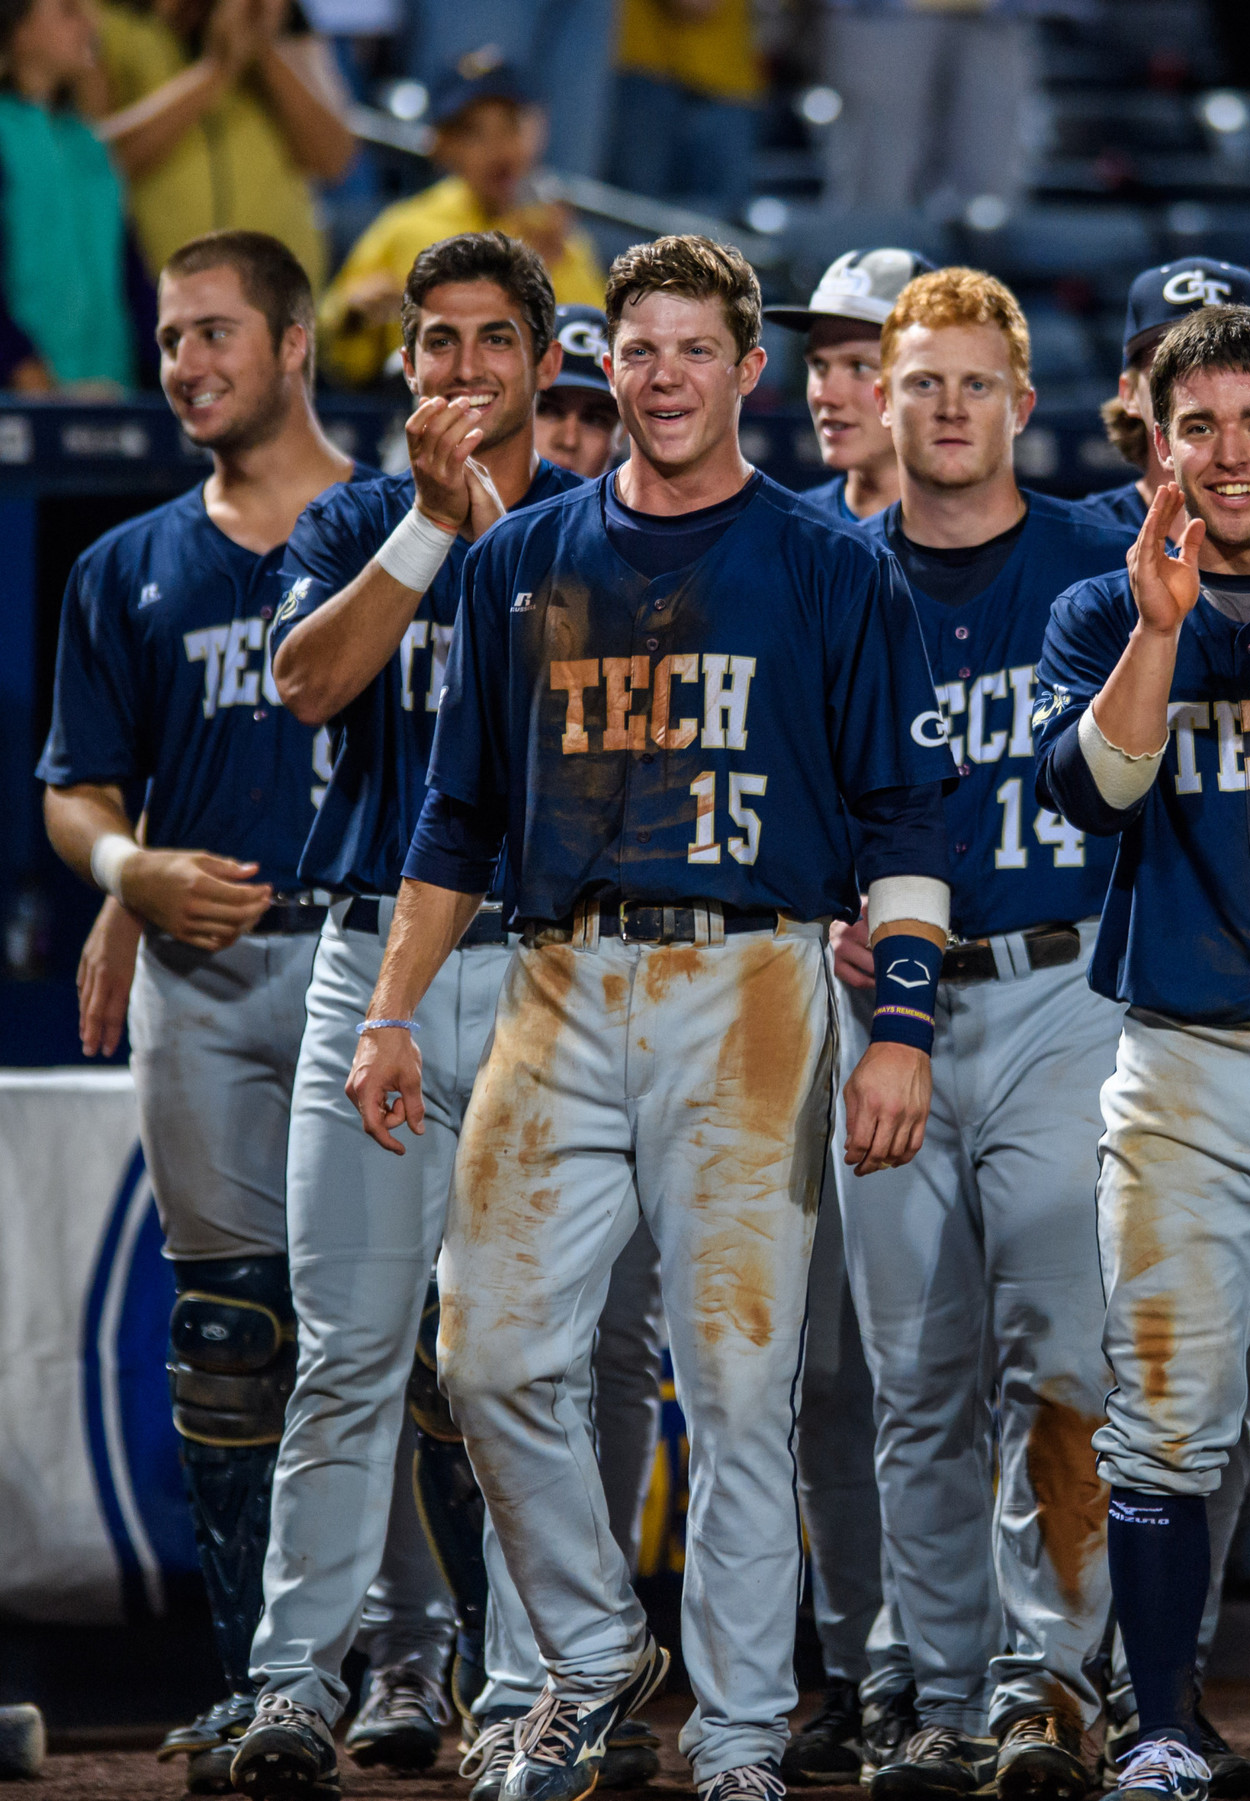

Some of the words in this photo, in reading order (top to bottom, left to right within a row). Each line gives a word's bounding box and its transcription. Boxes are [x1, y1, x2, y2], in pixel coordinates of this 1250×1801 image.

[1163, 269, 1231, 307] GT
[550, 653, 757, 755] TECH
[687, 770, 768, 866] 15
[994, 777, 1086, 869] 14
